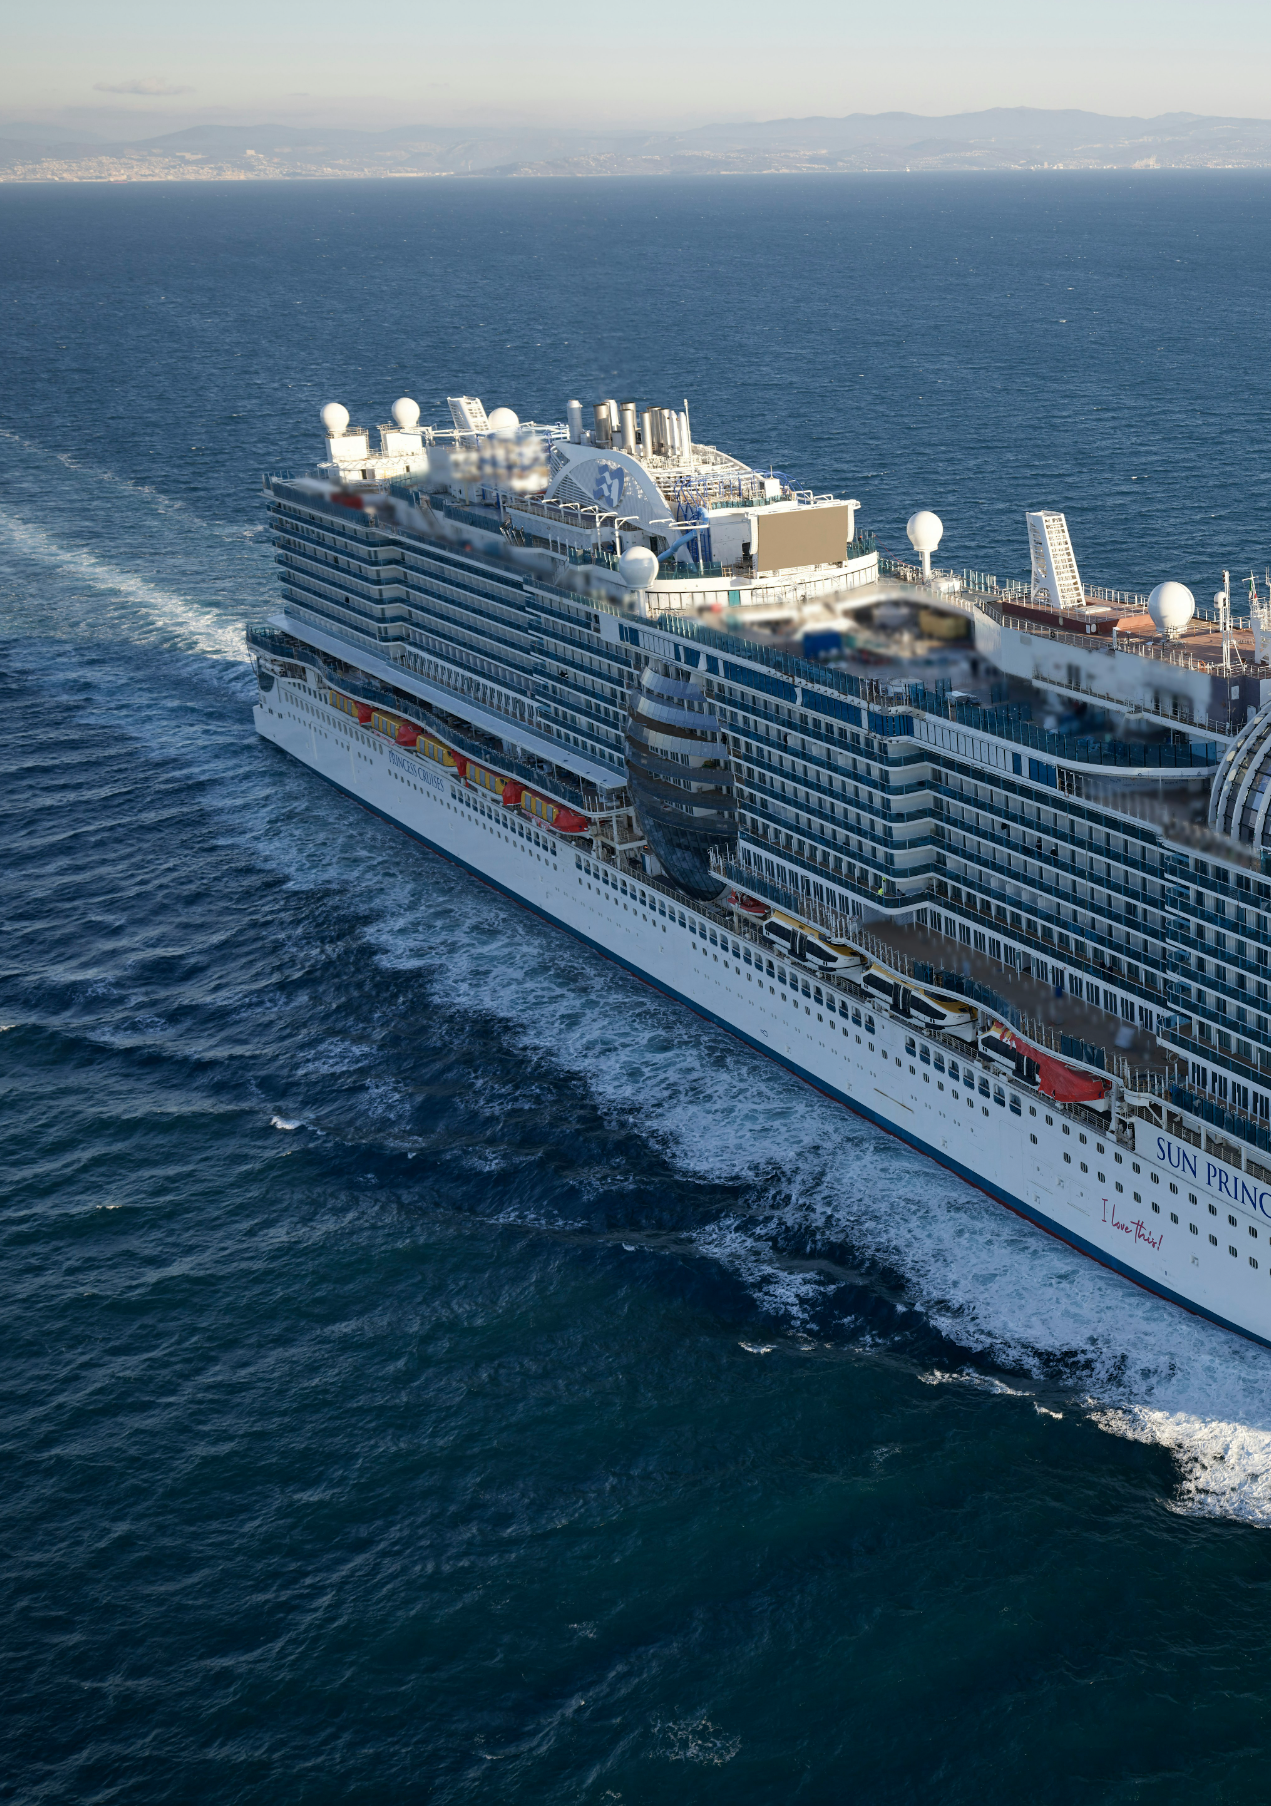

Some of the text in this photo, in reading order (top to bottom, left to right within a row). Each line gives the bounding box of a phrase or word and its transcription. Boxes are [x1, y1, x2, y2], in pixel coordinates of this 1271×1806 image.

[388, 750, 444, 792] PRINCESS CRUISES
[1156, 1136, 1198, 1179] SUN
[1101, 1198, 1108, 1222] I
[1111, 1203, 1132, 1233] love
